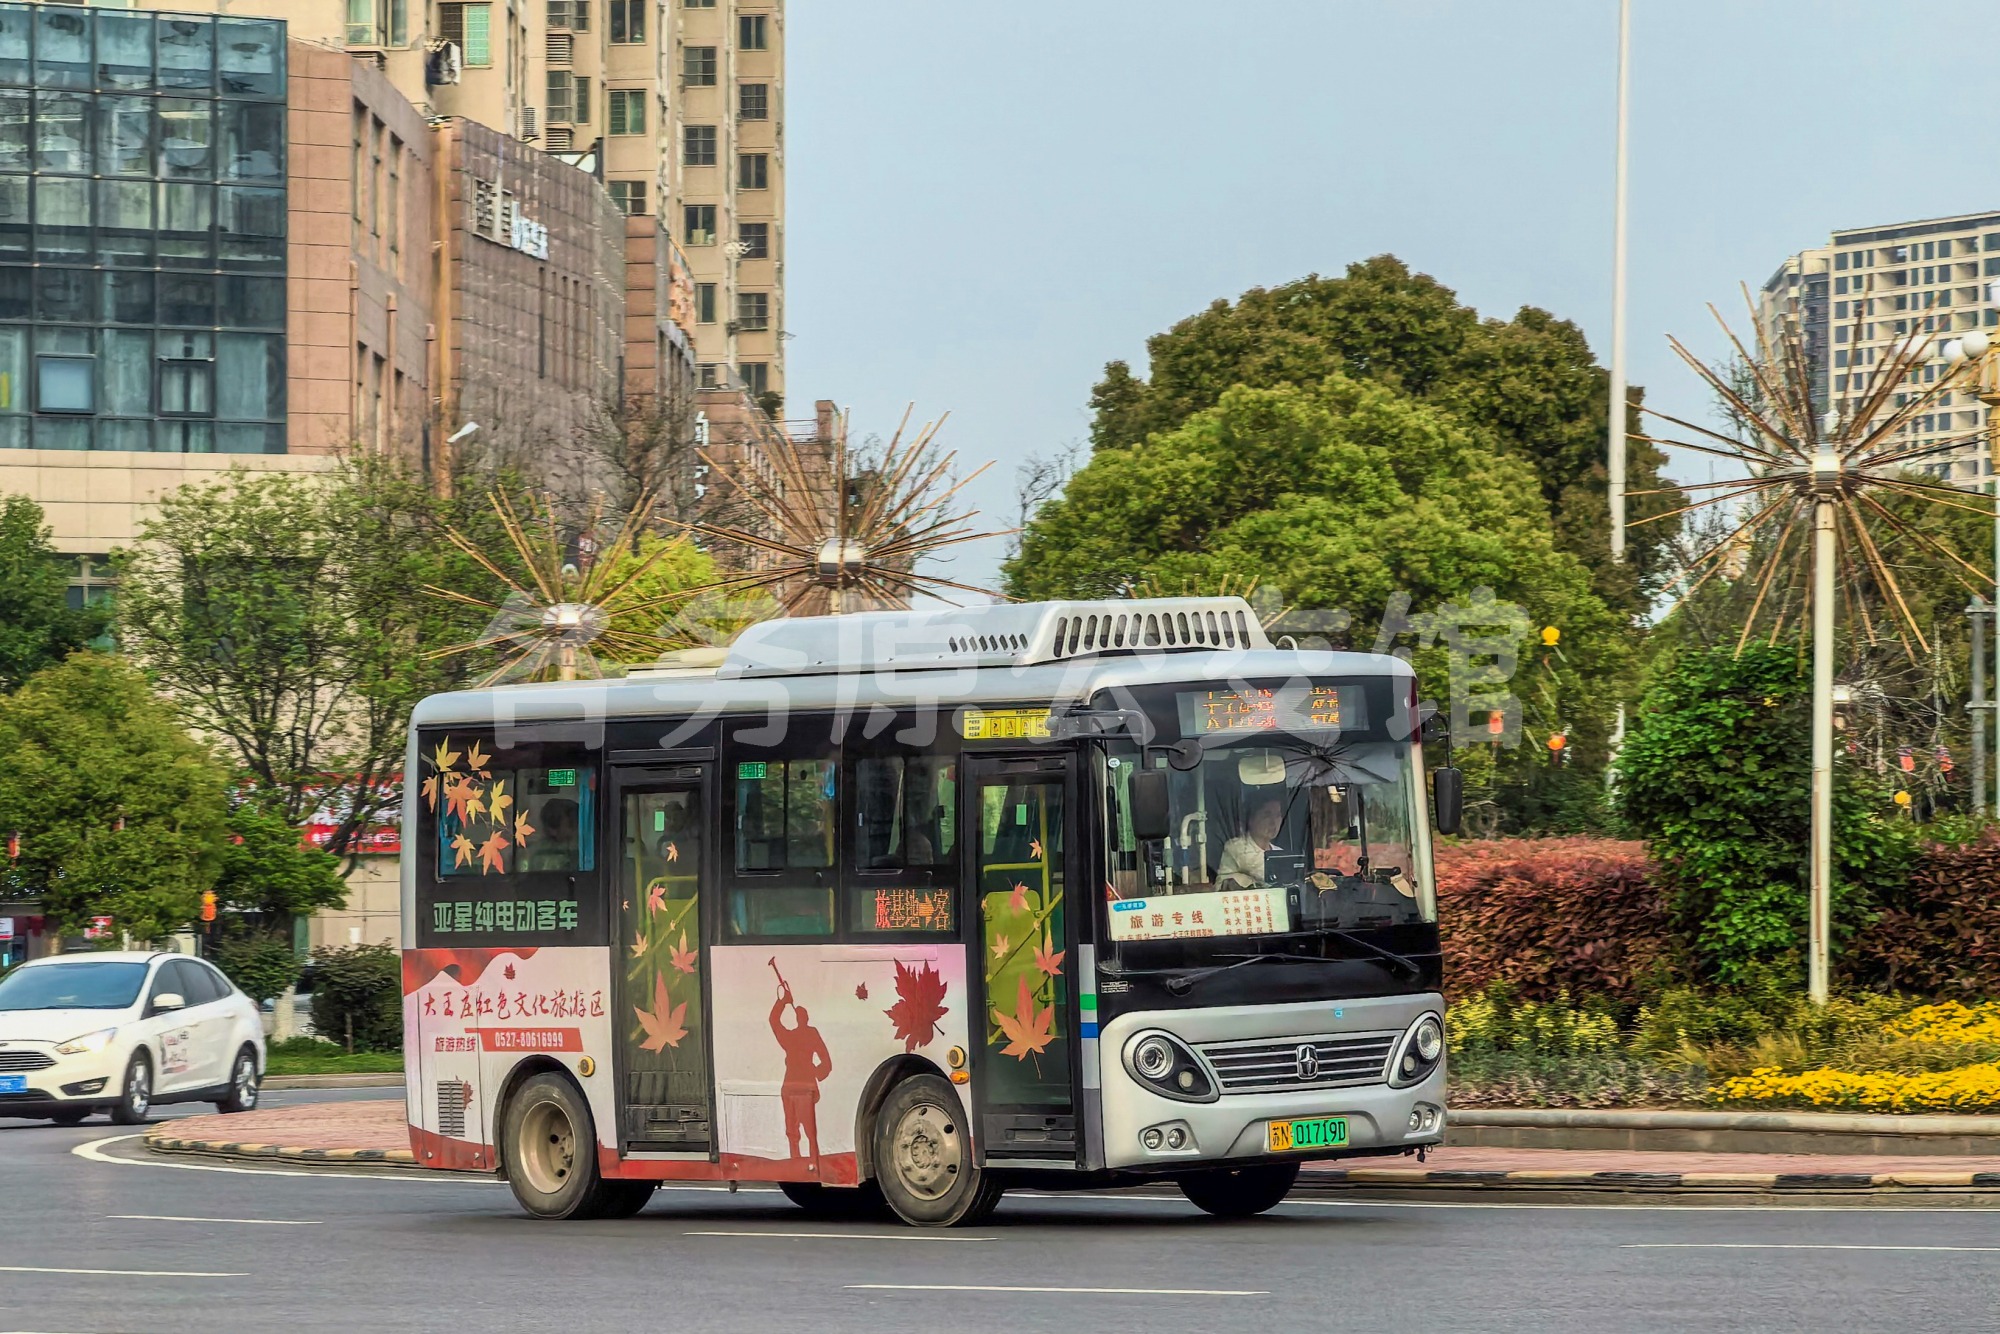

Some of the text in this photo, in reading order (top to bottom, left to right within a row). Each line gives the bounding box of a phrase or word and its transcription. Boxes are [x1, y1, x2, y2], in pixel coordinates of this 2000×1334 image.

[433, 900, 578, 932] 亚星纯电动客车
[1130, 910, 1204, 929] 旅游专线
[423, 988, 605, 1020] 大王庄红色文化旅游区
[435, 1036, 477, 1052] 旅游热线
[495, 1031, 563, 1048] 0527-80616999
